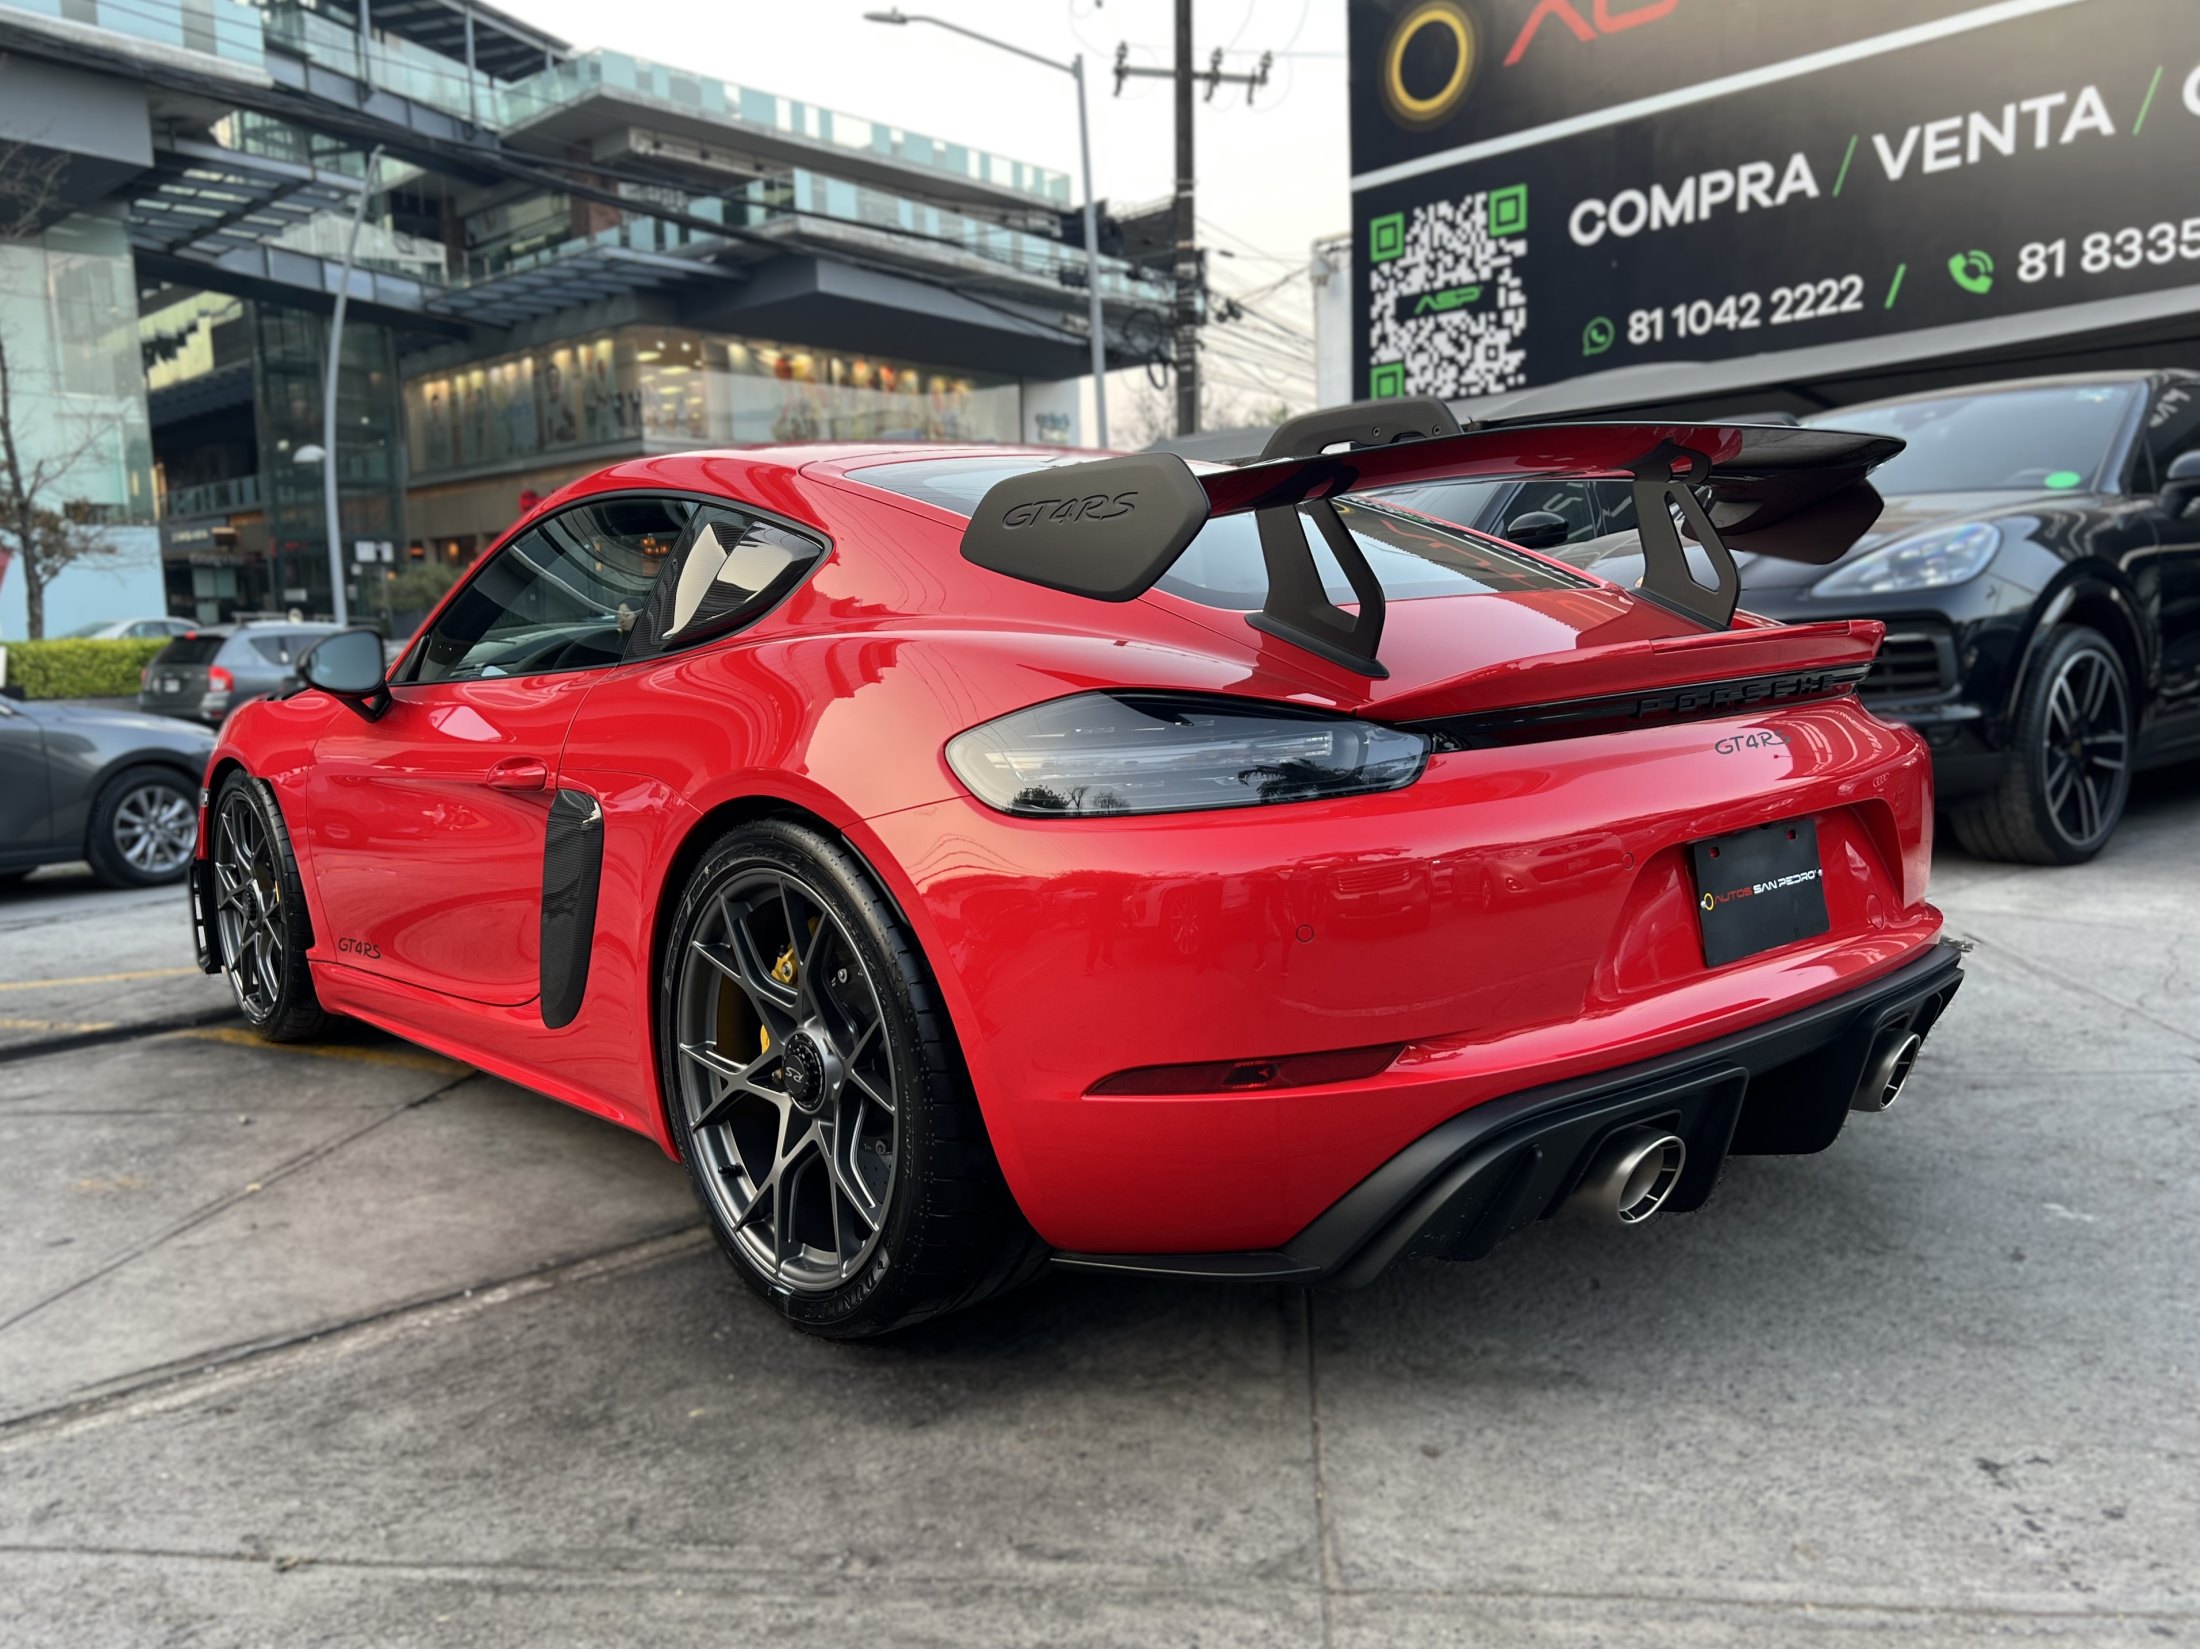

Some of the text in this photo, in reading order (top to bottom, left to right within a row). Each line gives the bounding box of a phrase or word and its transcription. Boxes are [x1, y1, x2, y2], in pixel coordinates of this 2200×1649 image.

[1568, 152, 1821, 247] COMPRA
[1870, 84, 2116, 182] VENTA
[1627, 306, 1664, 345] 81
[1671, 291, 1762, 338] 1042
[1769, 274, 1864, 325] 2222
[2016, 238, 2067, 283] 81
[2080, 216, 2200, 273] 8335
[1002, 491, 1139, 530] GT4RS
[1637, 673, 1834, 719] PORSCHE
[1714, 729, 1792, 756] GT4RS
[1715, 886, 1753, 905] AUTOS
[1753, 879, 1778, 895] SAN
[338, 937, 382, 959] GT4RS
